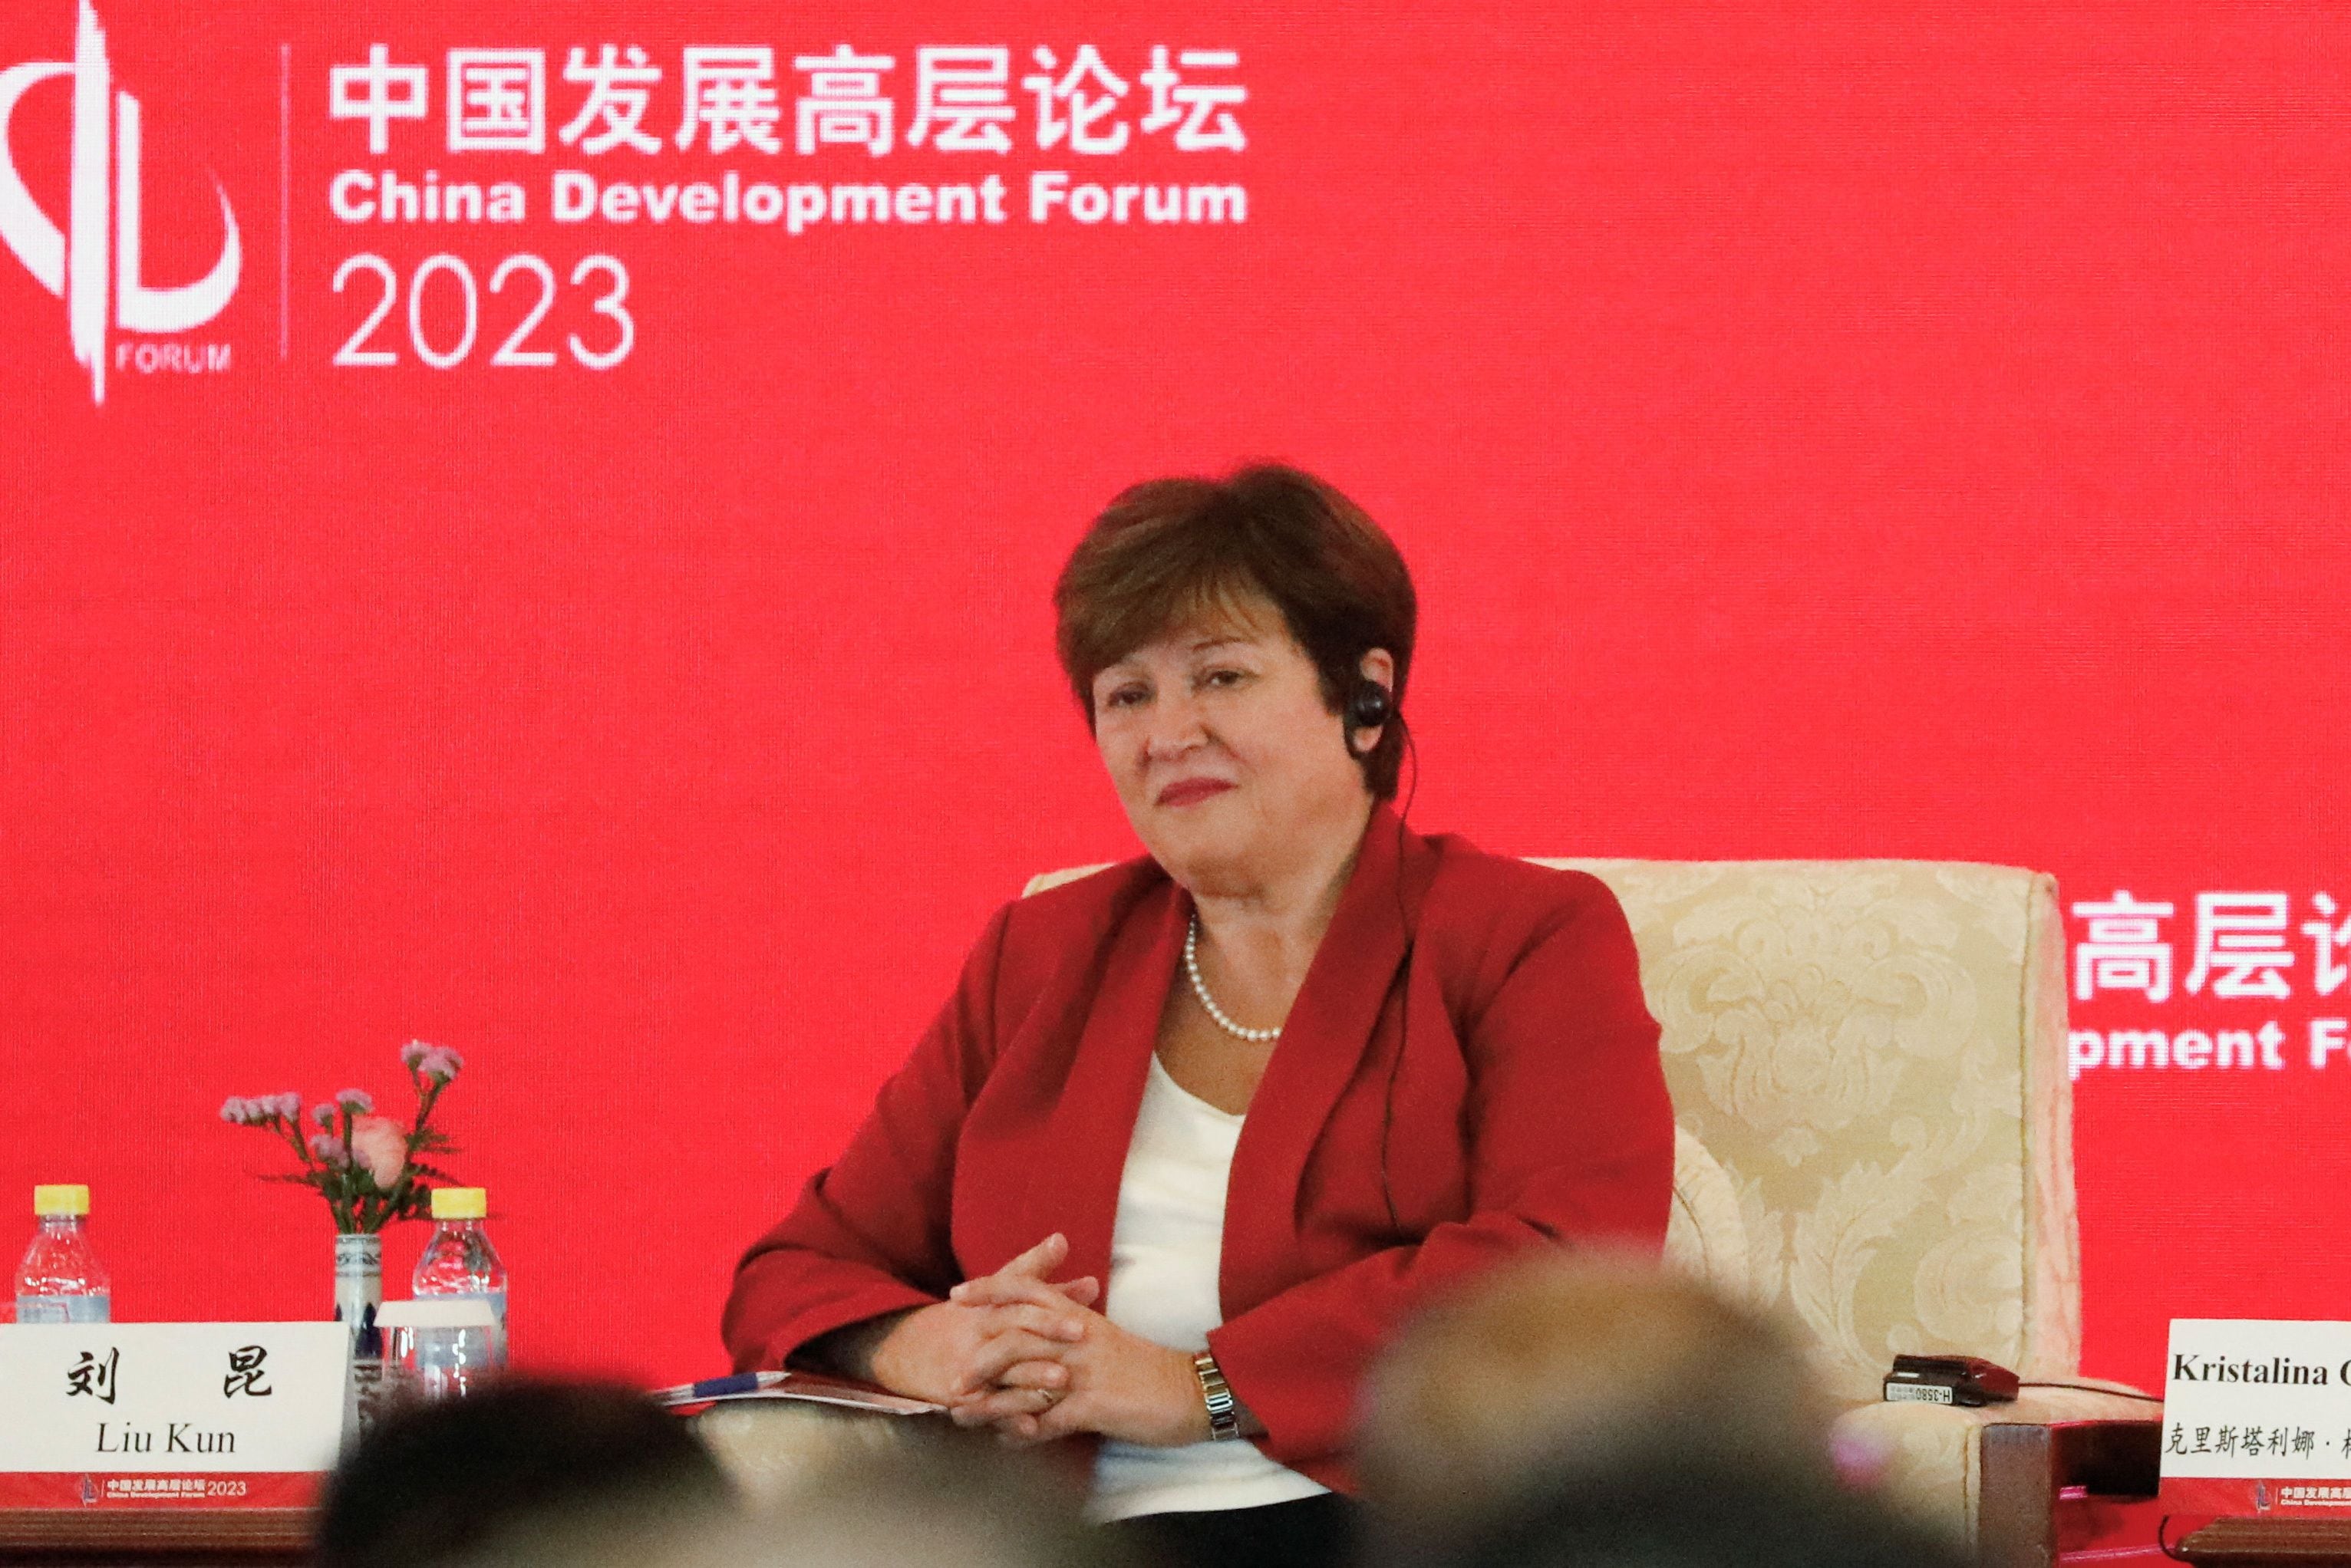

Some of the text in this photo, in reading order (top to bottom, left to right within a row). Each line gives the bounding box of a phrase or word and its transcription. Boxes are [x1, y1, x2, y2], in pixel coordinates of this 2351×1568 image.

[330, 44, 1247, 157] 中国发展高层论坛
[330, 170, 1247, 234] China Development Forum
[333, 253, 634, 370] 2023
[115, 342, 232, 374] FORUM
[66, 1346, 272, 1405] 刘 昆
[2174, 1354, 2328, 1385] Kristalina
[97, 1422, 235, 1453] Liu Kun
[207, 1481, 246, 1496] 2023
